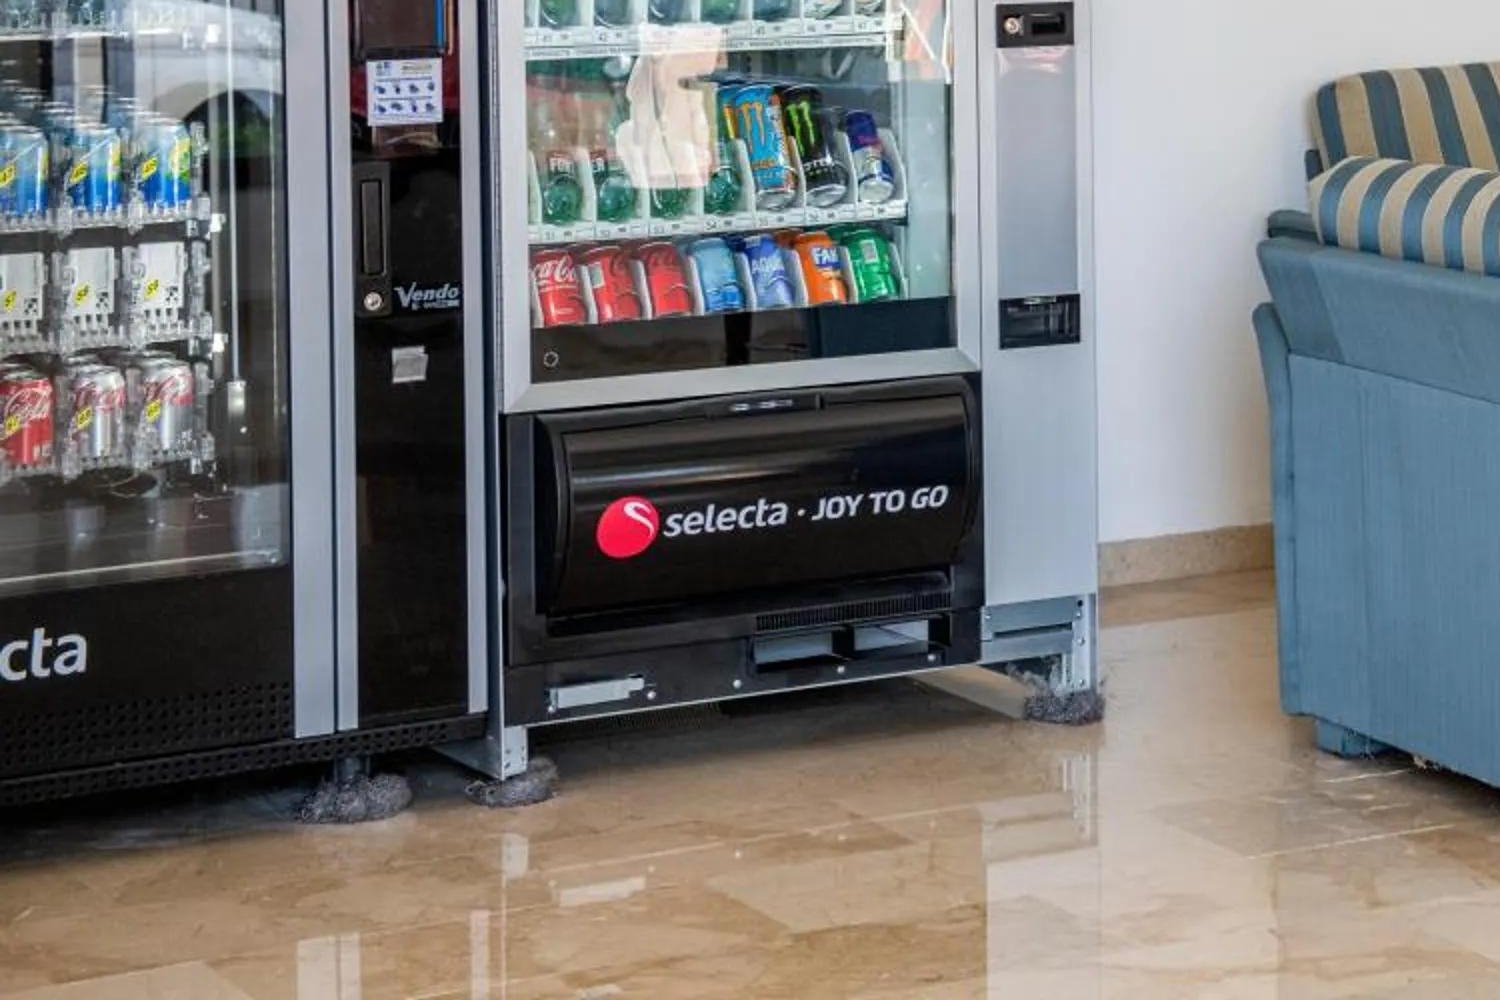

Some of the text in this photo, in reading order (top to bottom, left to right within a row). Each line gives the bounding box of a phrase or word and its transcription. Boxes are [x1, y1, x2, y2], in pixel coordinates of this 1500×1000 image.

[394, 282, 459, 307] Vendo
[663, 485, 949, 537] selecta JOY TO GO
[0, 627, 87, 681] cta
